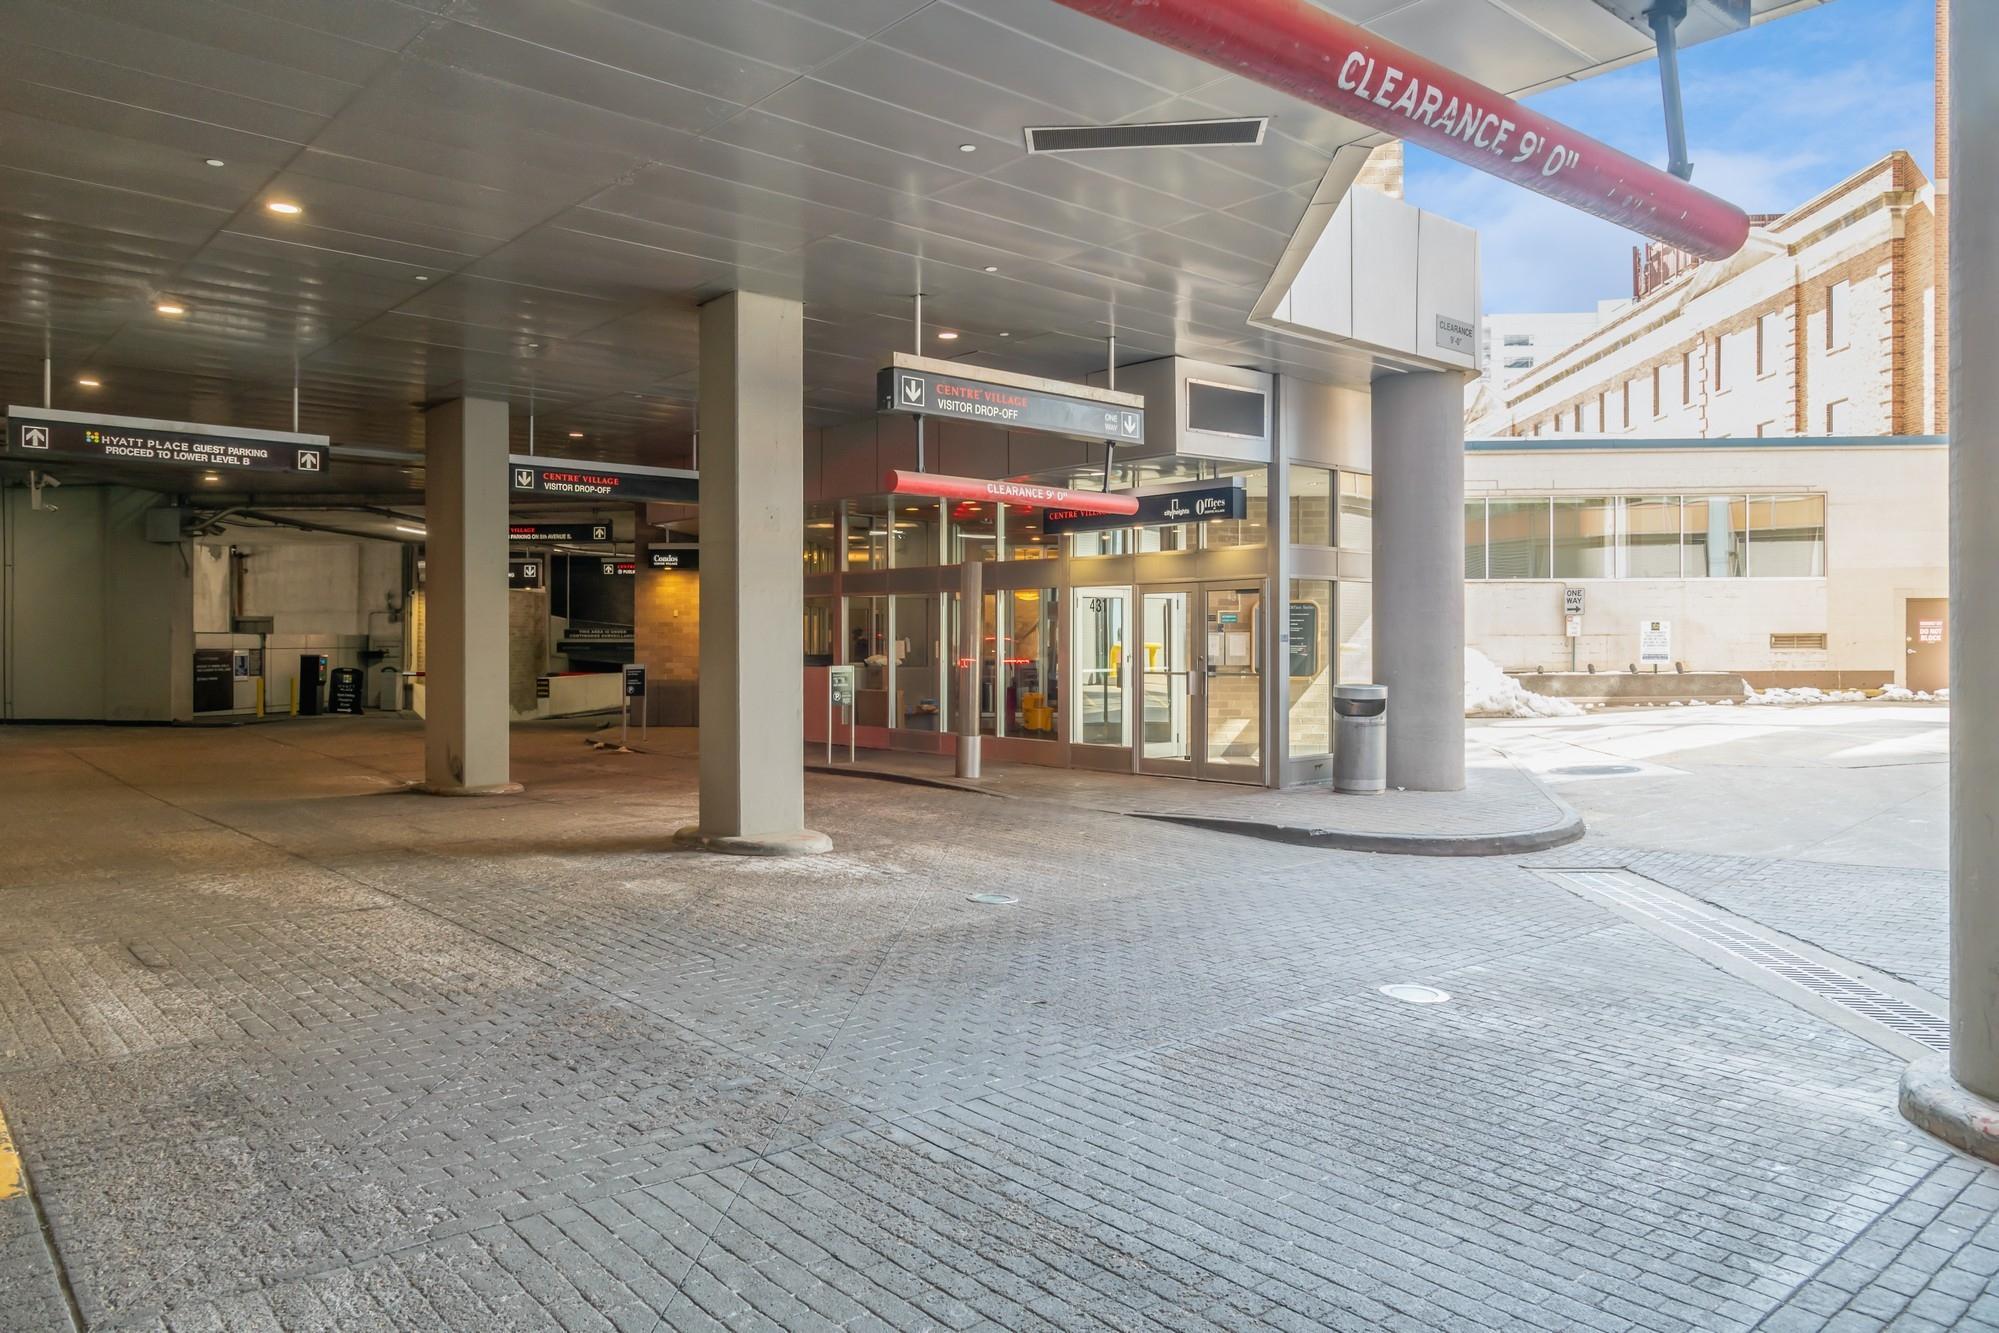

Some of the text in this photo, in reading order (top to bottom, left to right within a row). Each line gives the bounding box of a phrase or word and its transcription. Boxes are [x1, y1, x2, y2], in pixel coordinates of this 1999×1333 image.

[1337, 51, 1579, 177] CLEARANCE 9' 0"
[1440, 321, 1472, 338] CLEARANCE
[936, 384, 1028, 407] CENTRE VILLAGE
[937, 398, 1018, 420] VISITOR DROP-OFF
[1105, 413, 1118, 423] ONE
[1105, 423, 1118, 432] WAY
[101, 435, 268, 458] HYATT PLACE GUEST PARKING
[105, 446, 154, 458] PROCEED
[157, 450, 170, 459] TO
[174, 452, 208, 462] LOWER
[211, 454, 240, 465] LEVEL
[543, 472, 620, 486] CENTRE VILLAGE
[544, 482, 611, 495] VISITOR DROP-OFF
[987, 483, 1068, 501] CLEARANCE 9' 0"
[1196, 498, 1225, 515] Offices
[1049, 510, 1077, 521] CENTRE
[653, 554, 678, 562] Condos
[1567, 589, 1582, 597] ONE
